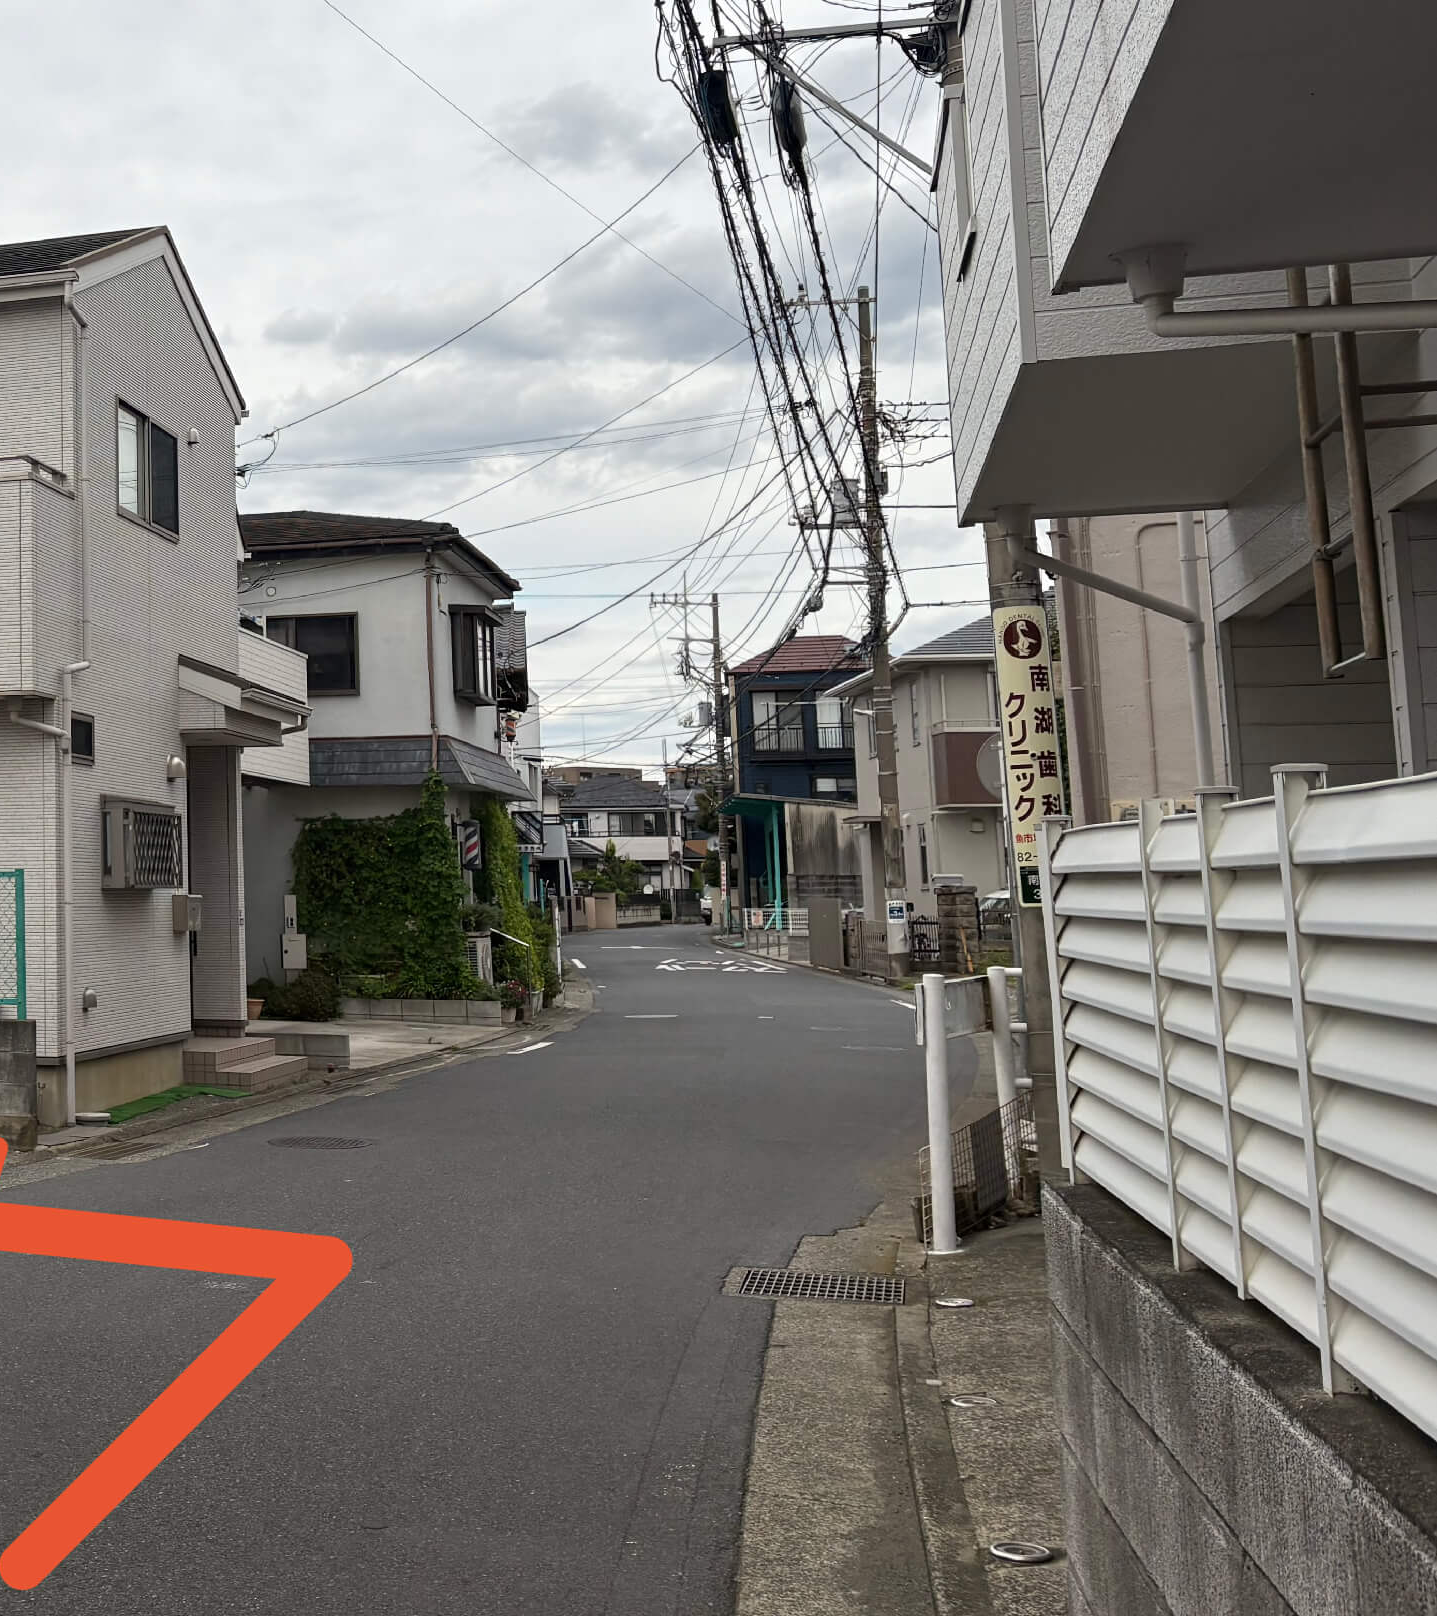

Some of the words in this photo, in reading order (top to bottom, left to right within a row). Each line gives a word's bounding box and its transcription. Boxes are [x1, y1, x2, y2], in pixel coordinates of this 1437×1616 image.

[1005, 692, 1036, 823] クリニック
[1029, 664, 1062, 816] 南湖歯科
[1015, 833, 1036, 844] 魚市
